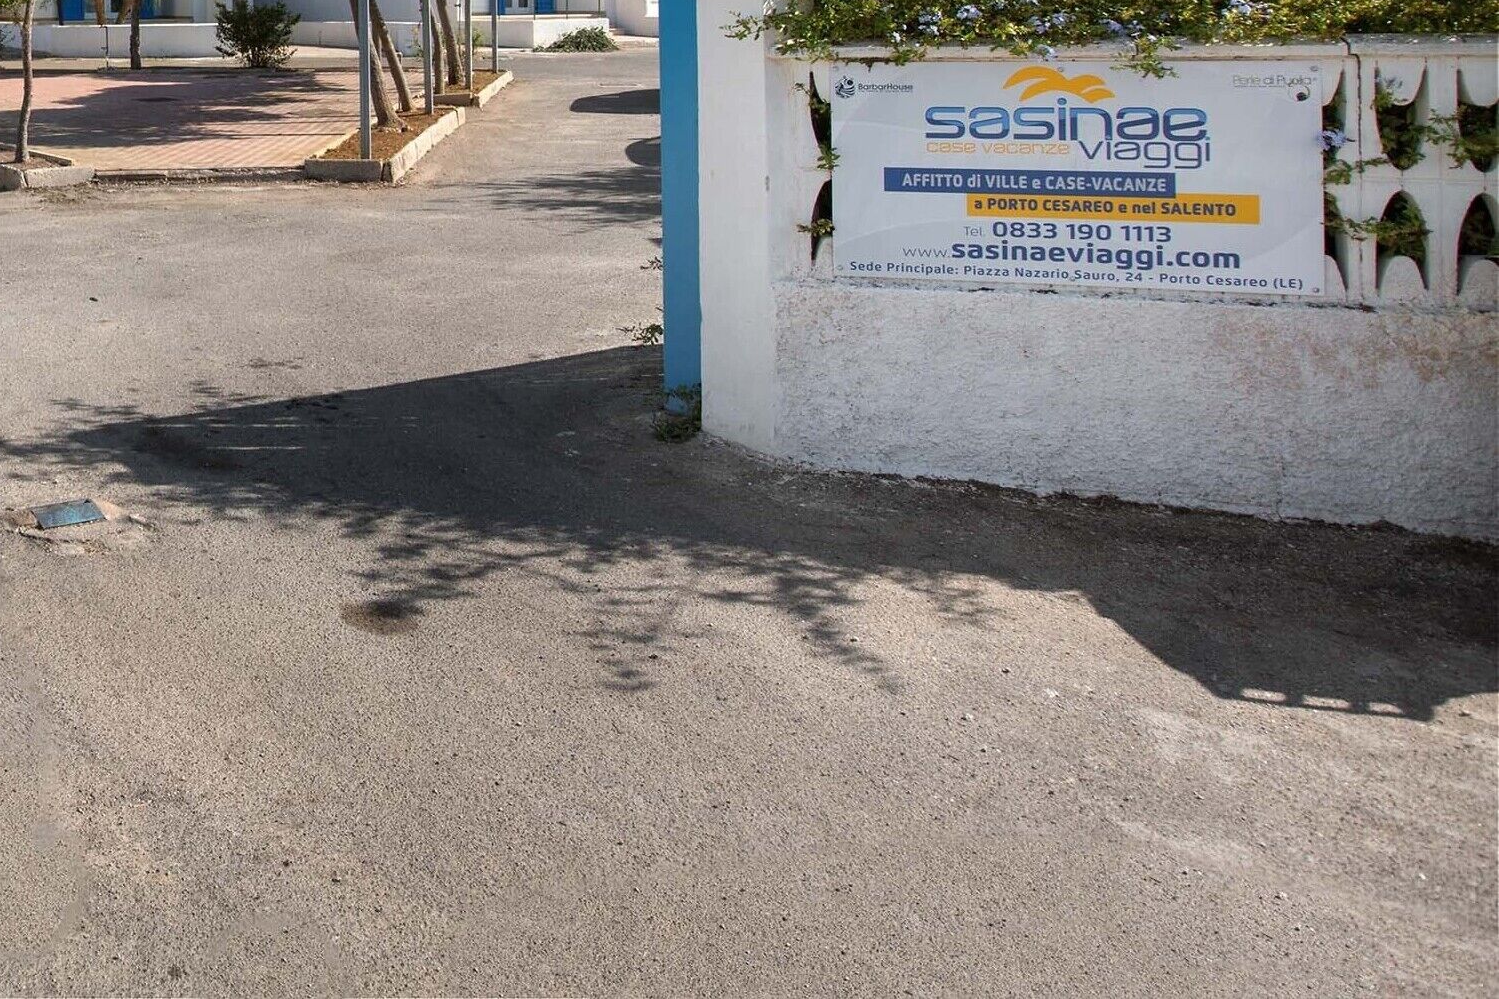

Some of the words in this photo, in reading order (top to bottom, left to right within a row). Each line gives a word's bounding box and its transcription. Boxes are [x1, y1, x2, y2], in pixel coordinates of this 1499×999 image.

[925, 97, 1207, 141] sasinae
[926, 142, 976, 153] case
[983, 142, 1070, 155] vacanze
[1078, 135, 1211, 169] viaggi
[902, 173, 963, 188] AFFITTO
[967, 173, 981, 188] di
[984, 174, 1028, 189] VILLE
[1031, 178, 1041, 189] e
[1045, 175, 1167, 192] CASE-VACANZE
[974, 200, 983, 210] a
[987, 198, 1038, 211] PORTO
[1042, 199, 1114, 213] CESAREO
[1118, 204, 1127, 214] e
[1132, 201, 1156, 214] nel
[1161, 202, 1236, 216] SALENTO
[992, 221, 1058, 240] 0833
[1066, 223, 1112, 241] 190
[1120, 225, 1172, 243] 1113
[902, 240, 1240, 271] www.sasinaeviaggi.com
[850, 261, 882, 272] Sede
[886, 262, 959, 276] Principale:
[963, 265, 1010, 277] Piazza
[1014, 267, 1069, 280] Nazario
[1074, 269, 1120, 283] Sauro,
[1125, 272, 1143, 282] 24
[1159, 273, 1201, 285] Porto
[1206, 275, 1268, 288] Cesareo
[1272, 277, 1303, 290] (LE)
